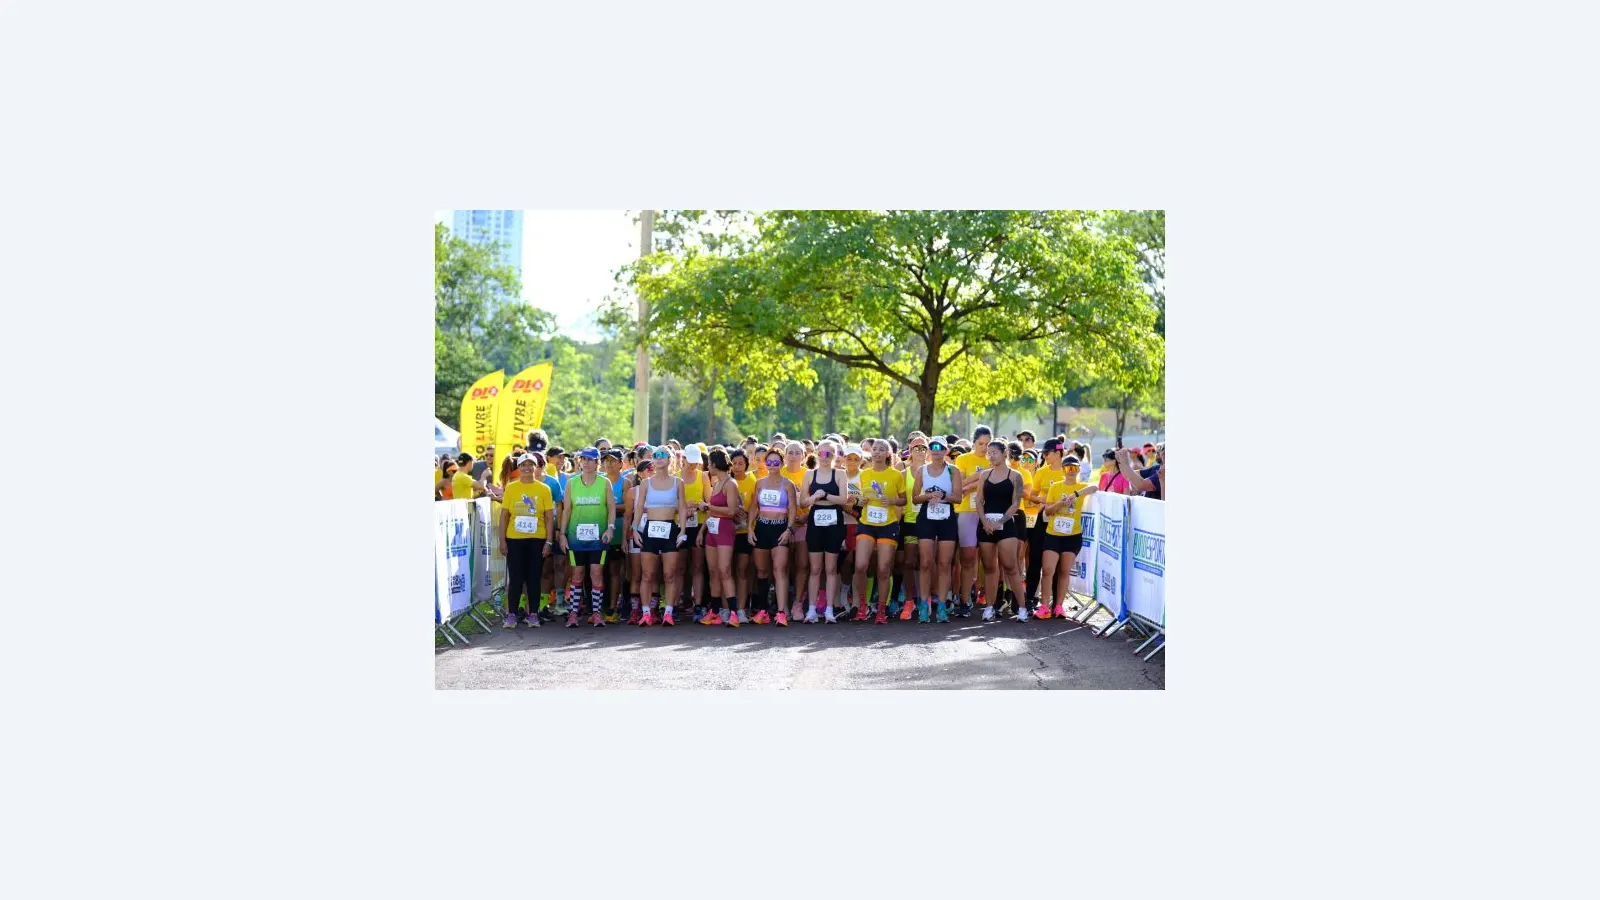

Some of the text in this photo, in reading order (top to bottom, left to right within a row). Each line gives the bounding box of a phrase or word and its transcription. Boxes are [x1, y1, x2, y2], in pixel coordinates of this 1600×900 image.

[476, 405, 485, 441] LIVRE
[513, 399, 526, 440] LIVRE
[816, 513, 832, 521] 228
[868, 511, 883, 519] 413
[516, 521, 532, 529] 414
[651, 525, 666, 533] 376
[1056, 521, 1071, 529] 179
